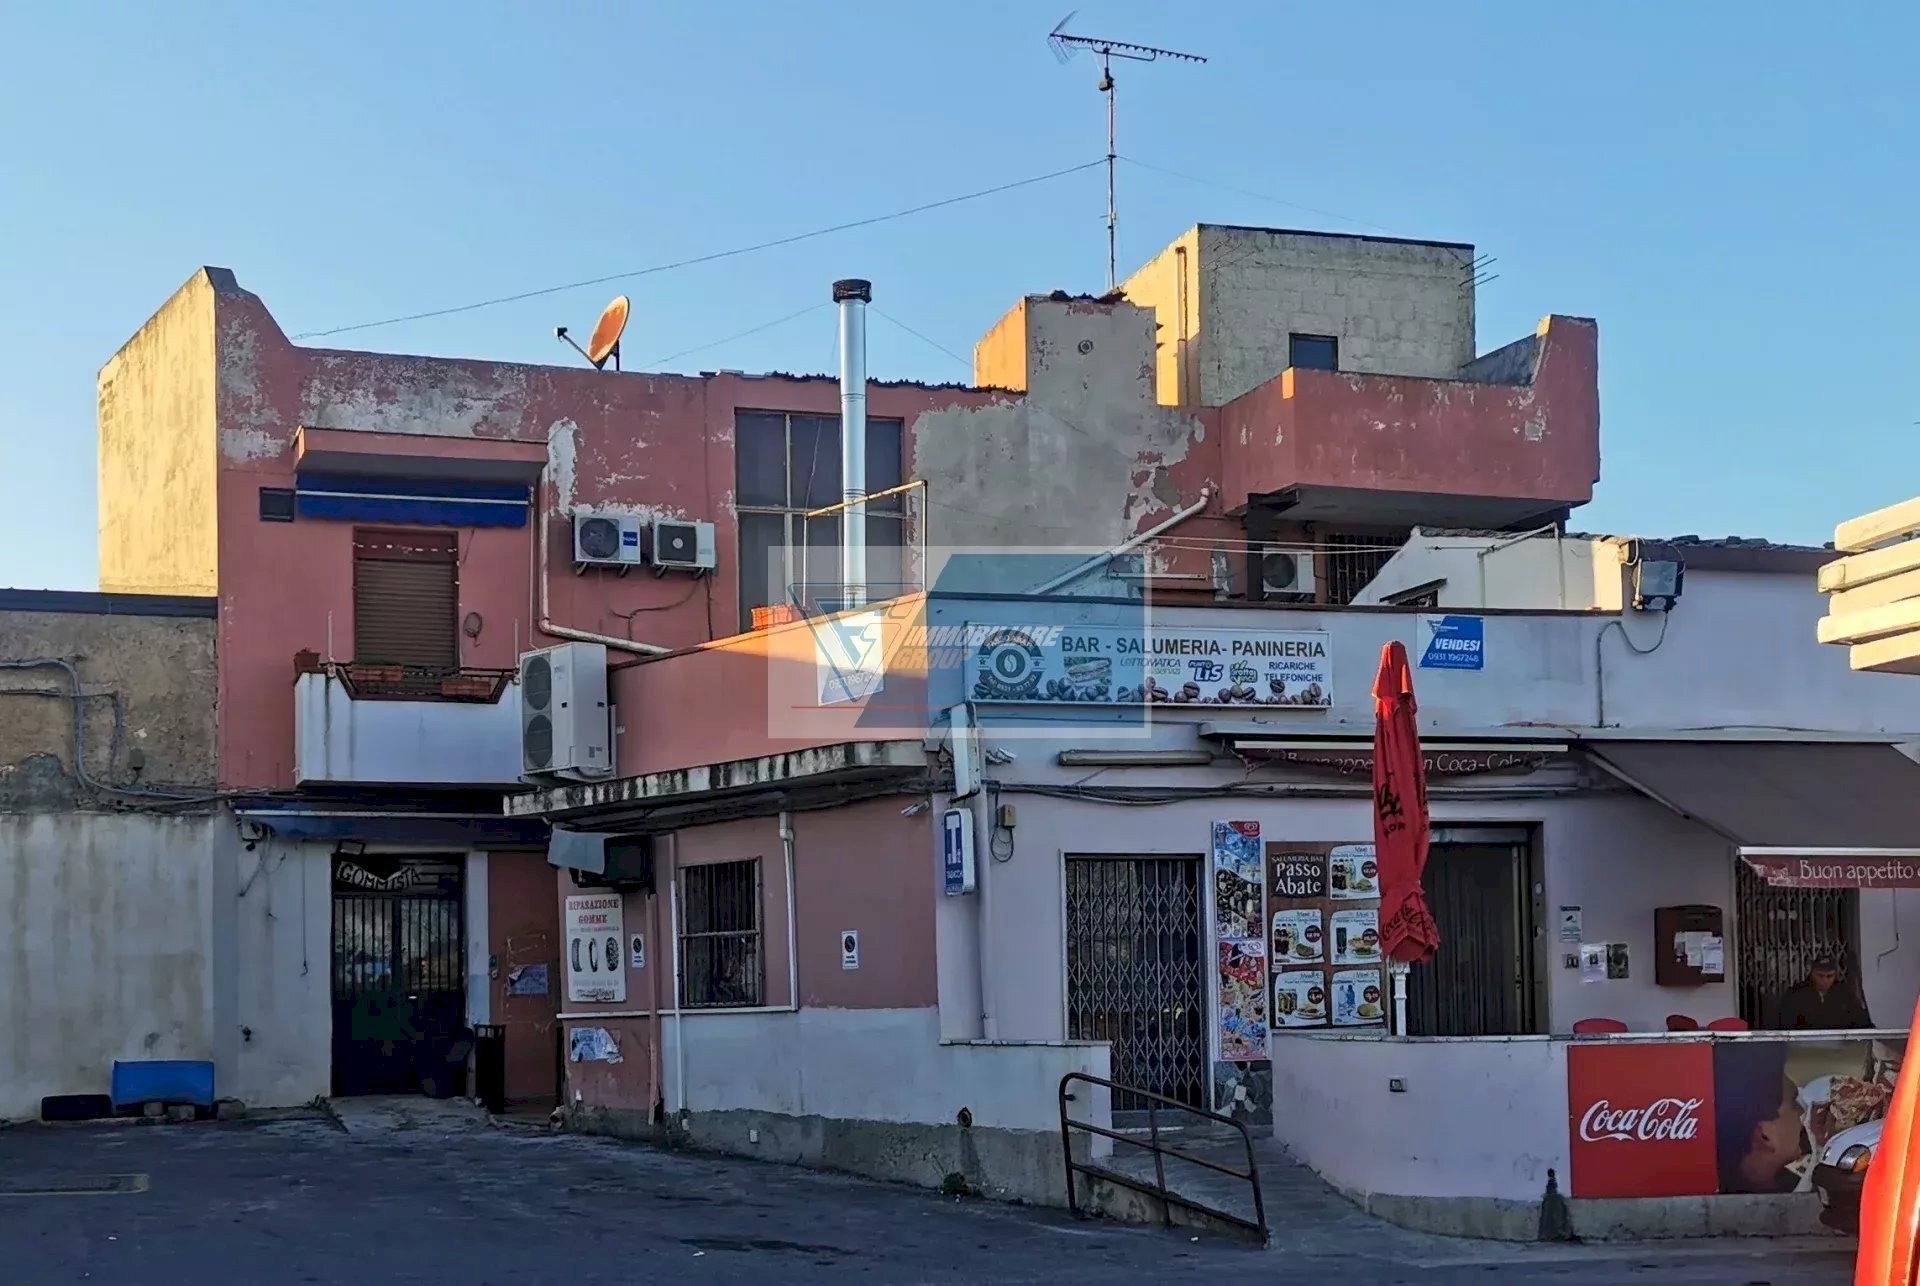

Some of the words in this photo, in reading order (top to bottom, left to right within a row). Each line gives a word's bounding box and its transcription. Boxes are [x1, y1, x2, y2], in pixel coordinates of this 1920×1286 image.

[1061, 636, 1100, 653] BAR
[1232, 640, 1326, 657] PANINERIA
[1435, 638, 1481, 652] VENDESI
[1428, 652, 1447, 661] 0931
[1268, 661, 1316, 671] RICARICHE
[1264, 673, 1323, 682] TELEFONICHE
[336, 861, 421, 890] GOMMISTA
[1276, 861, 1321, 878] Passo
[1799, 859, 1842, 879] Buon
[1846, 860, 1914, 886] appetito
[1275, 877, 1322, 895] Abate
[569, 899, 619, 911] RIPARAZIONE
[578, 914, 608, 925] GOMME
[1579, 1097, 1704, 1142] Coca-Cola
